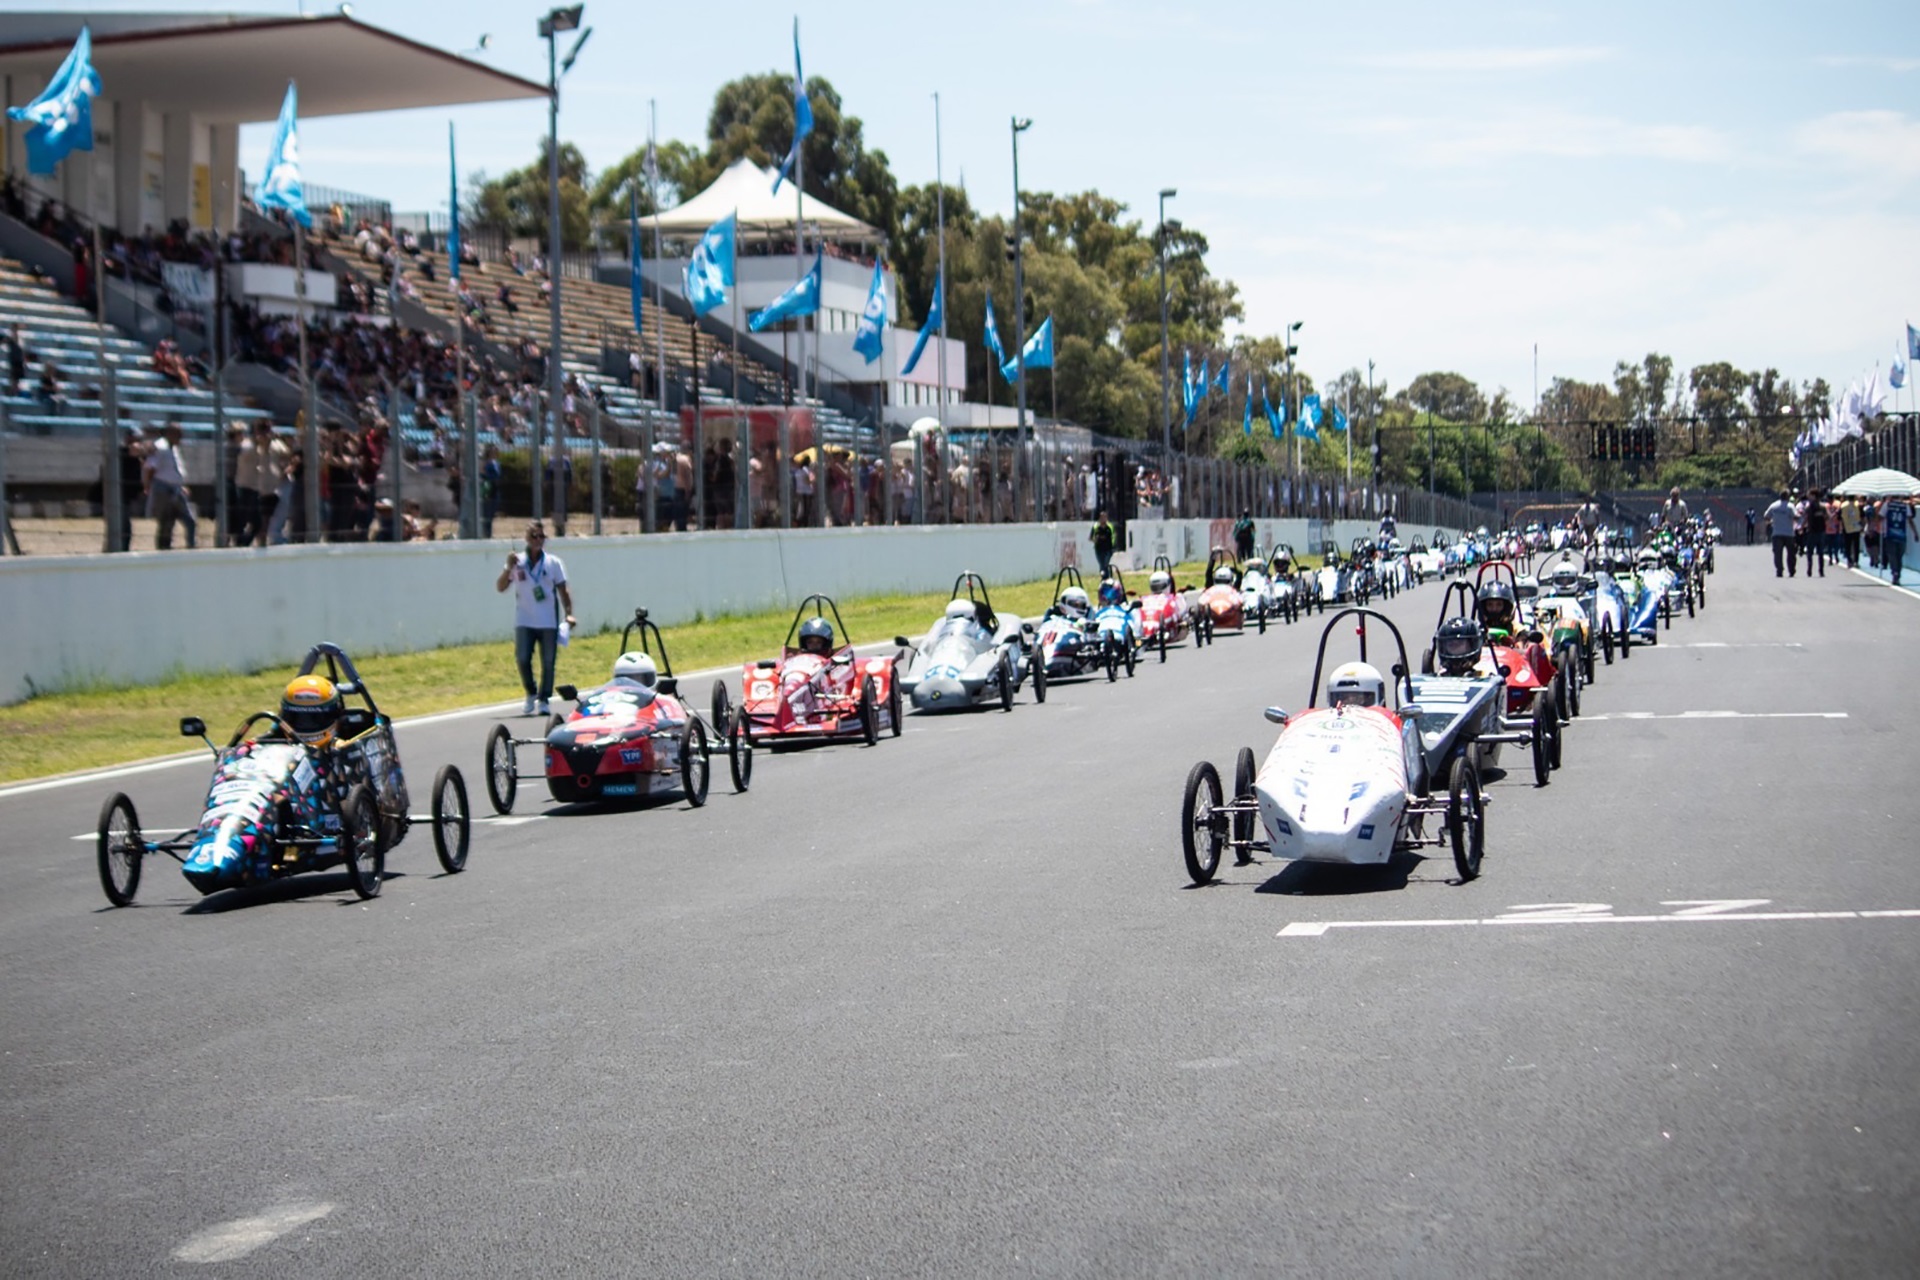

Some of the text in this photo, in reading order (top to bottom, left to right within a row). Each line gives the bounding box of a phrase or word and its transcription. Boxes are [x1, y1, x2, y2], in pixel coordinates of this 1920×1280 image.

[288, 705, 323, 713] HONDA
[624, 752, 641, 761] YPF
[602, 785, 637, 794] SIEMENS
